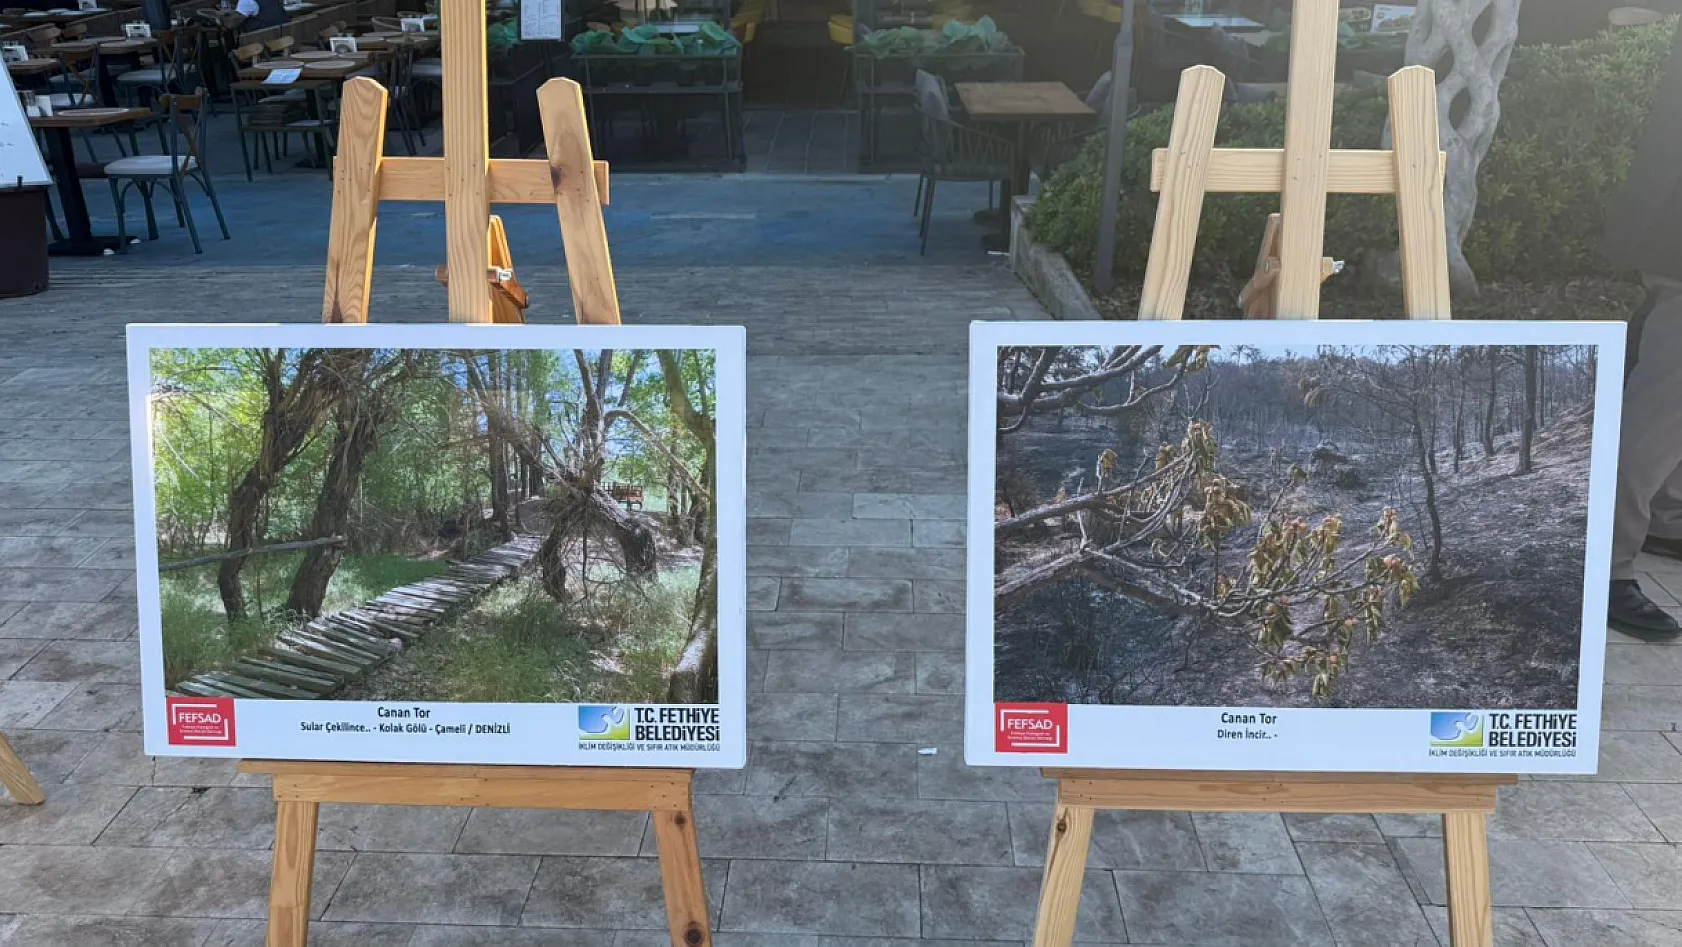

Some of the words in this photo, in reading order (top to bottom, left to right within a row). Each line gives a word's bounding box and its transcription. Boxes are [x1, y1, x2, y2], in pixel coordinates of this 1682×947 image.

[178, 712, 222, 723] FEFSAD
[377, 706, 411, 718] Canan
[413, 707, 431, 719] Tor
[634, 707, 657, 723] T.C.
[1221, 712, 1256, 724] Canan
[1259, 713, 1277, 724] Tor
[1007, 718, 1053, 730] FEFSAD
[1488, 713, 1512, 730] T.C.
[300, 721, 324, 731] Sular
[379, 722, 404, 733] Kolak
[405, 722, 428, 734] Gölü
[434, 723, 467, 735] Çameli
[474, 721, 511, 734] DENİZLİ
[1217, 729, 1243, 739] Diren
